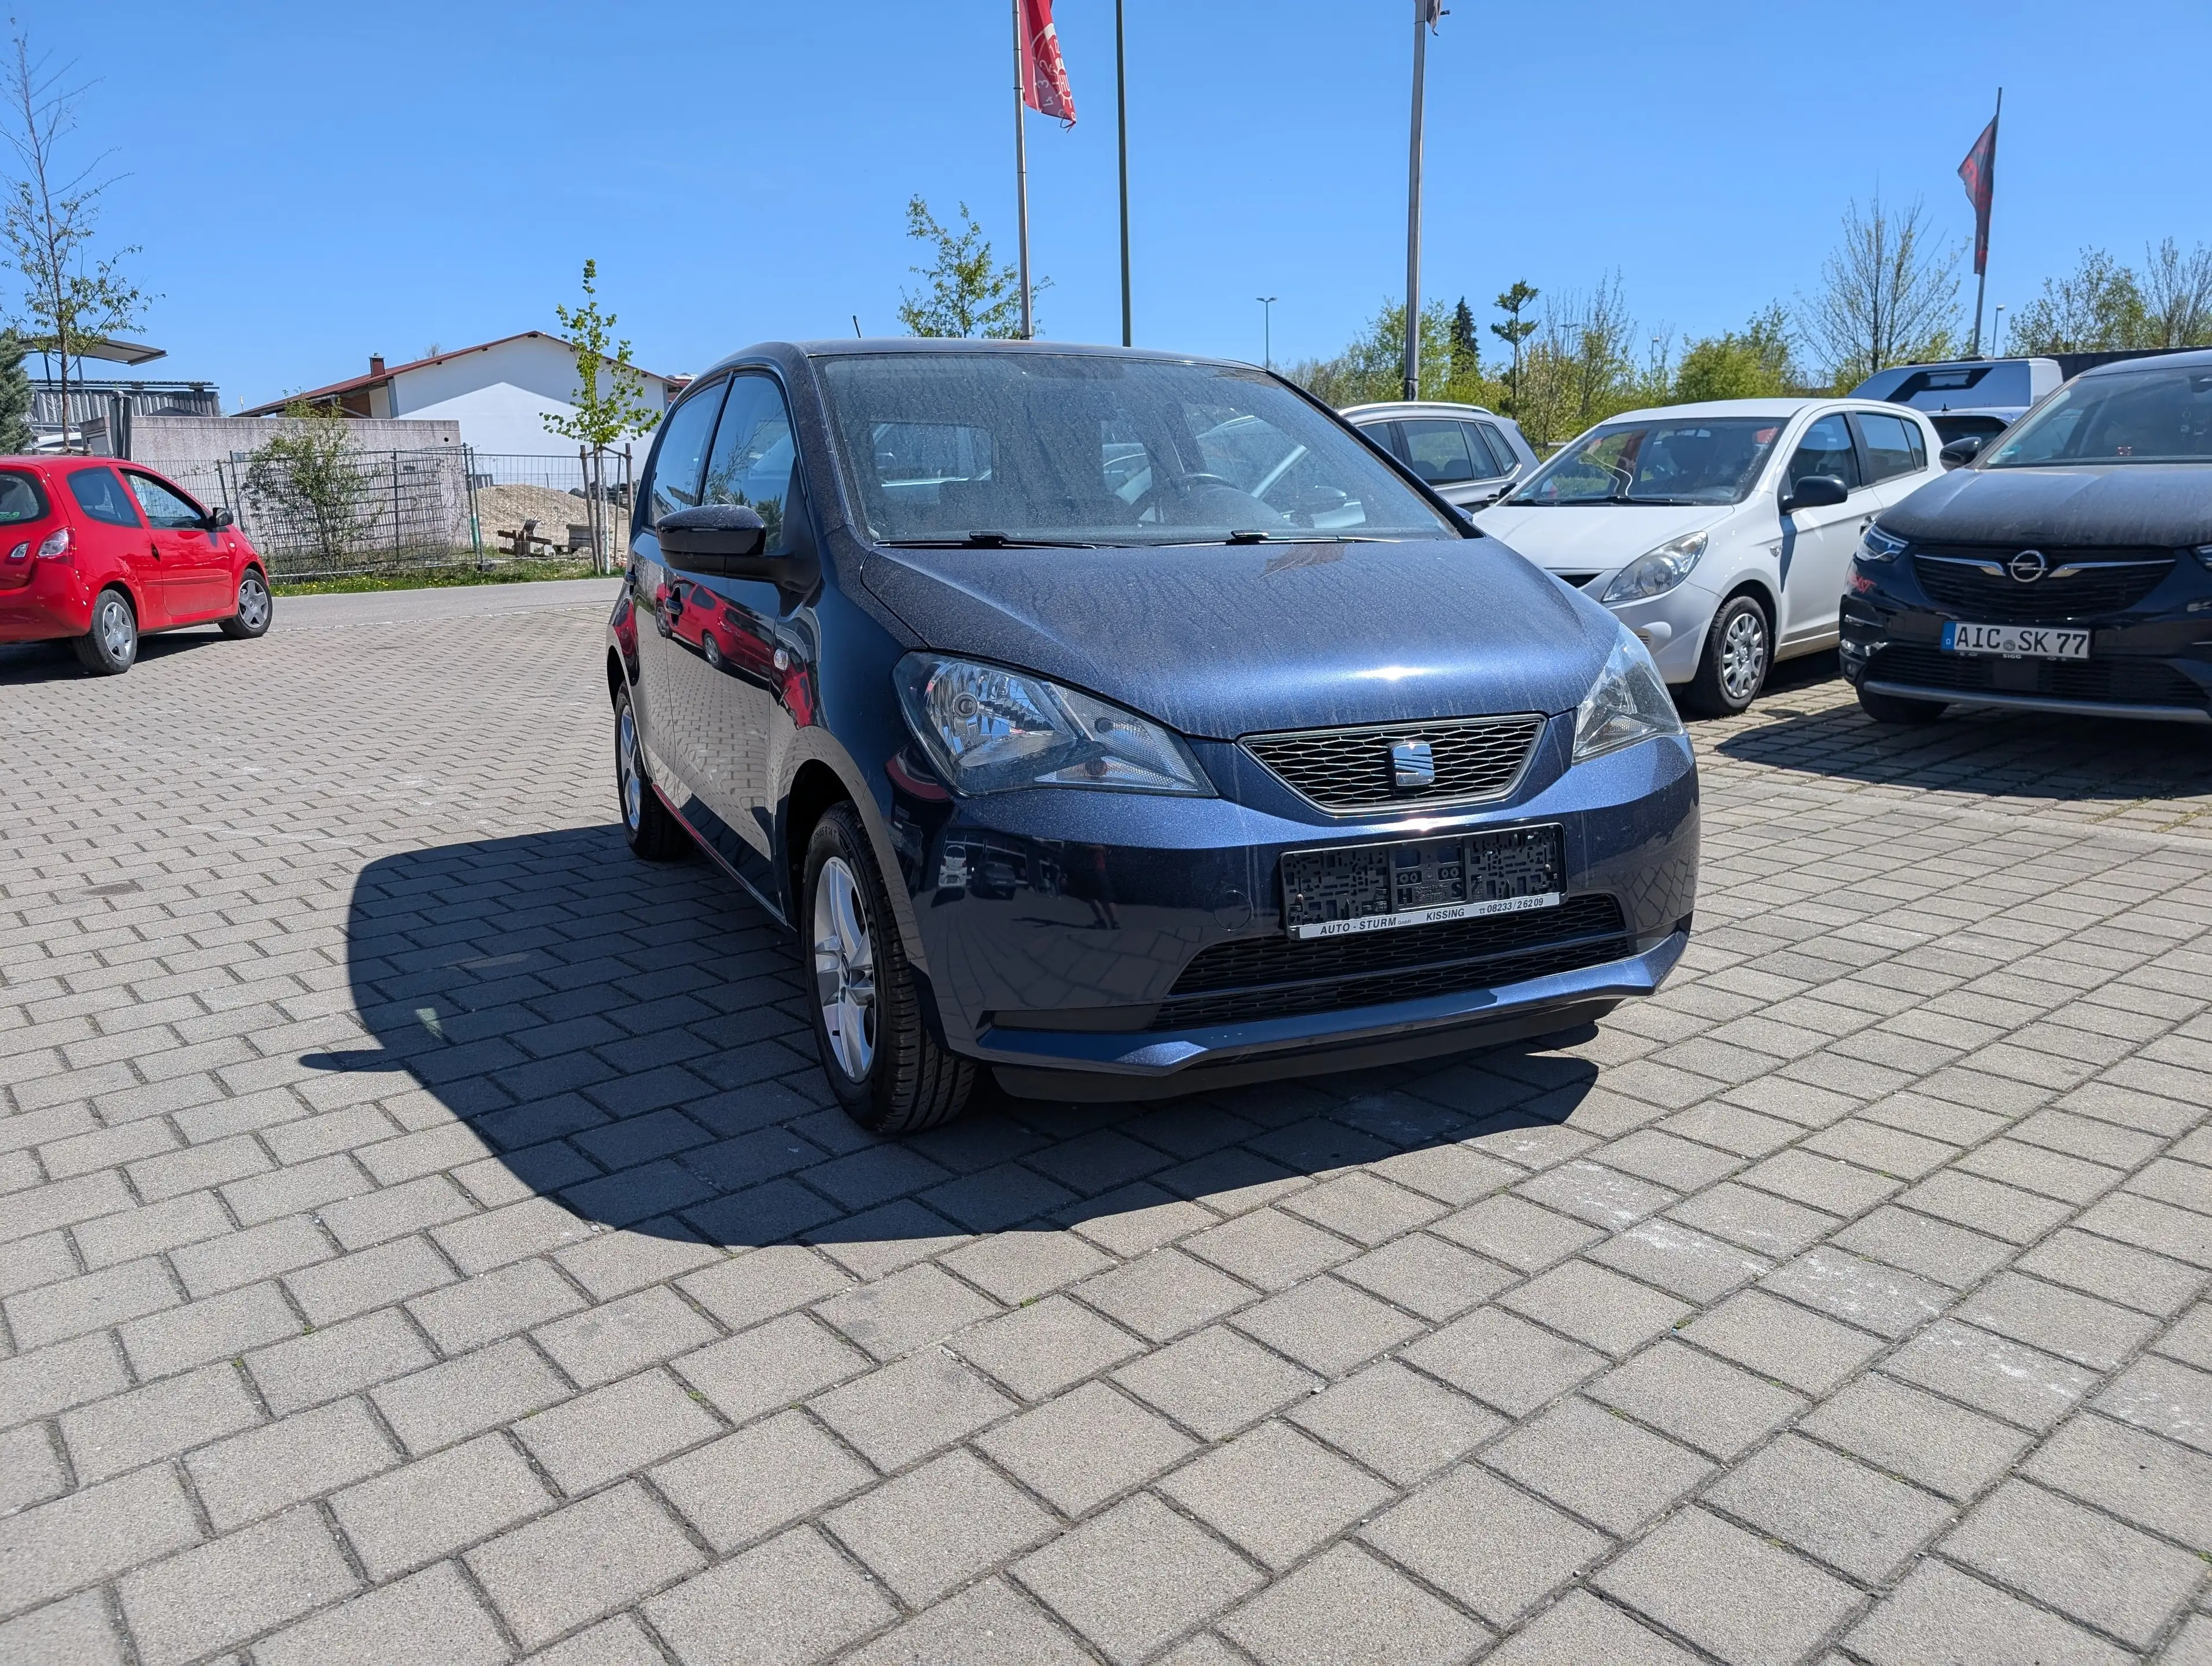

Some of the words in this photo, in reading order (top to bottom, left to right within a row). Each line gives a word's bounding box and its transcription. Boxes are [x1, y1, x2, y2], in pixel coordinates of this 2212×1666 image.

[1956, 626, 2000, 649] AIC
[2018, 631, 2049, 653] SK
[2056, 632, 2087, 655] 77
[1320, 923, 1350, 935] AUTO
[1359, 917, 1397, 930] STURM
[1426, 908, 1465, 922] KISSING
